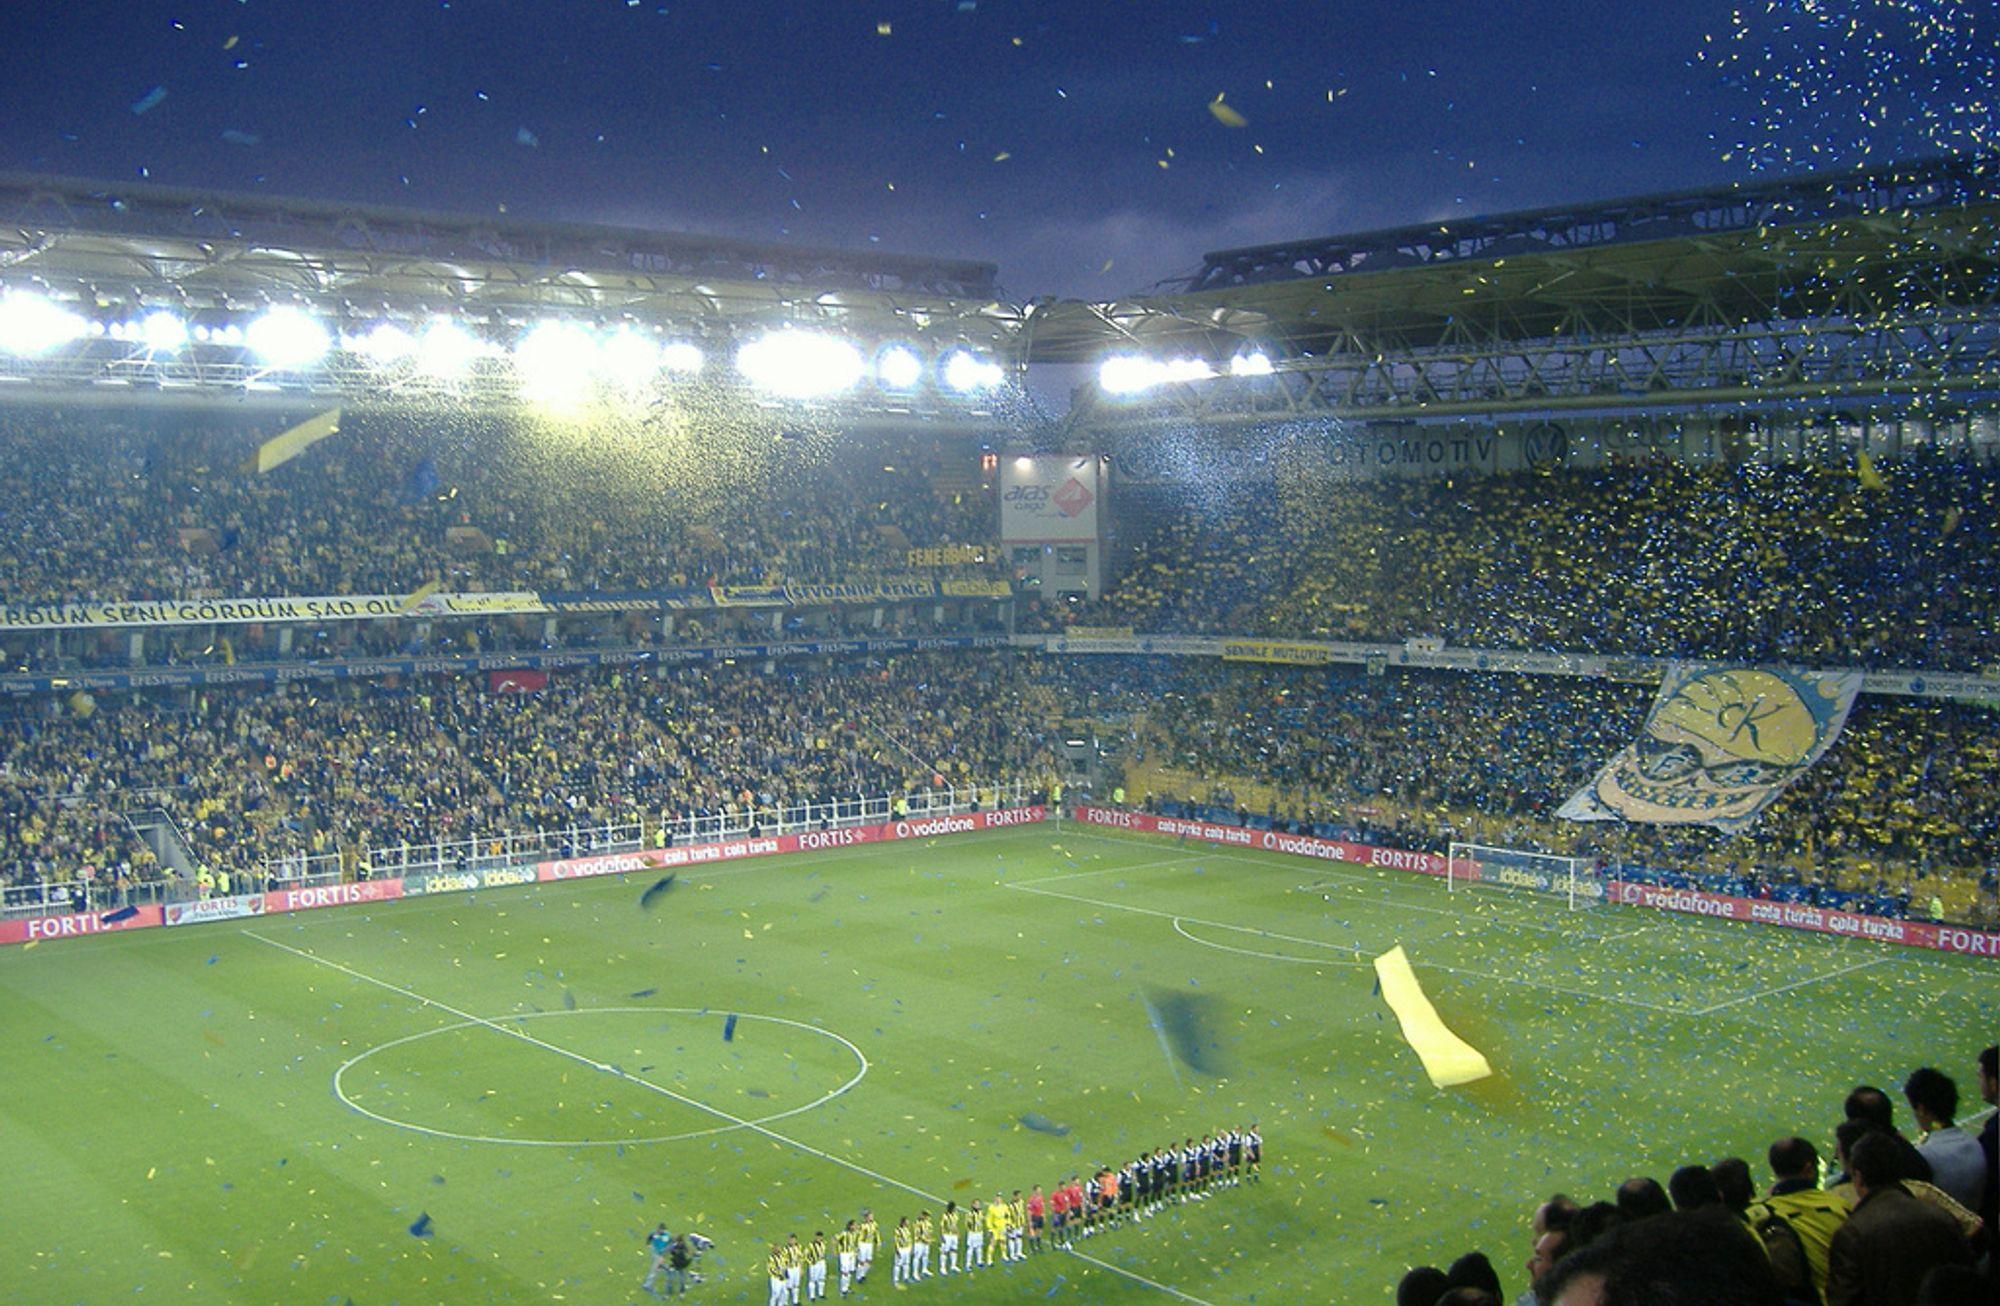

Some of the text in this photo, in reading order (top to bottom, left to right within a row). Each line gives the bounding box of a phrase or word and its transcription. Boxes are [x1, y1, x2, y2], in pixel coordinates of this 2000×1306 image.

[179, 597, 299, 621] GÖRDÜM
[912, 817, 974, 838] vodafone
[986, 806, 1031, 826] FORTIS
[1087, 808, 1130, 827] FORTIS
[799, 830, 853, 850] FORTIS
[1278, 835, 1345, 860] vodafone
[1371, 848, 1428, 872] FORTIS
[287, 884, 361, 909] FORTIS
[1644, 891, 1734, 917] vodafone
[1752, 903, 1781, 921] cola
[1862, 921, 1904, 940] turka
